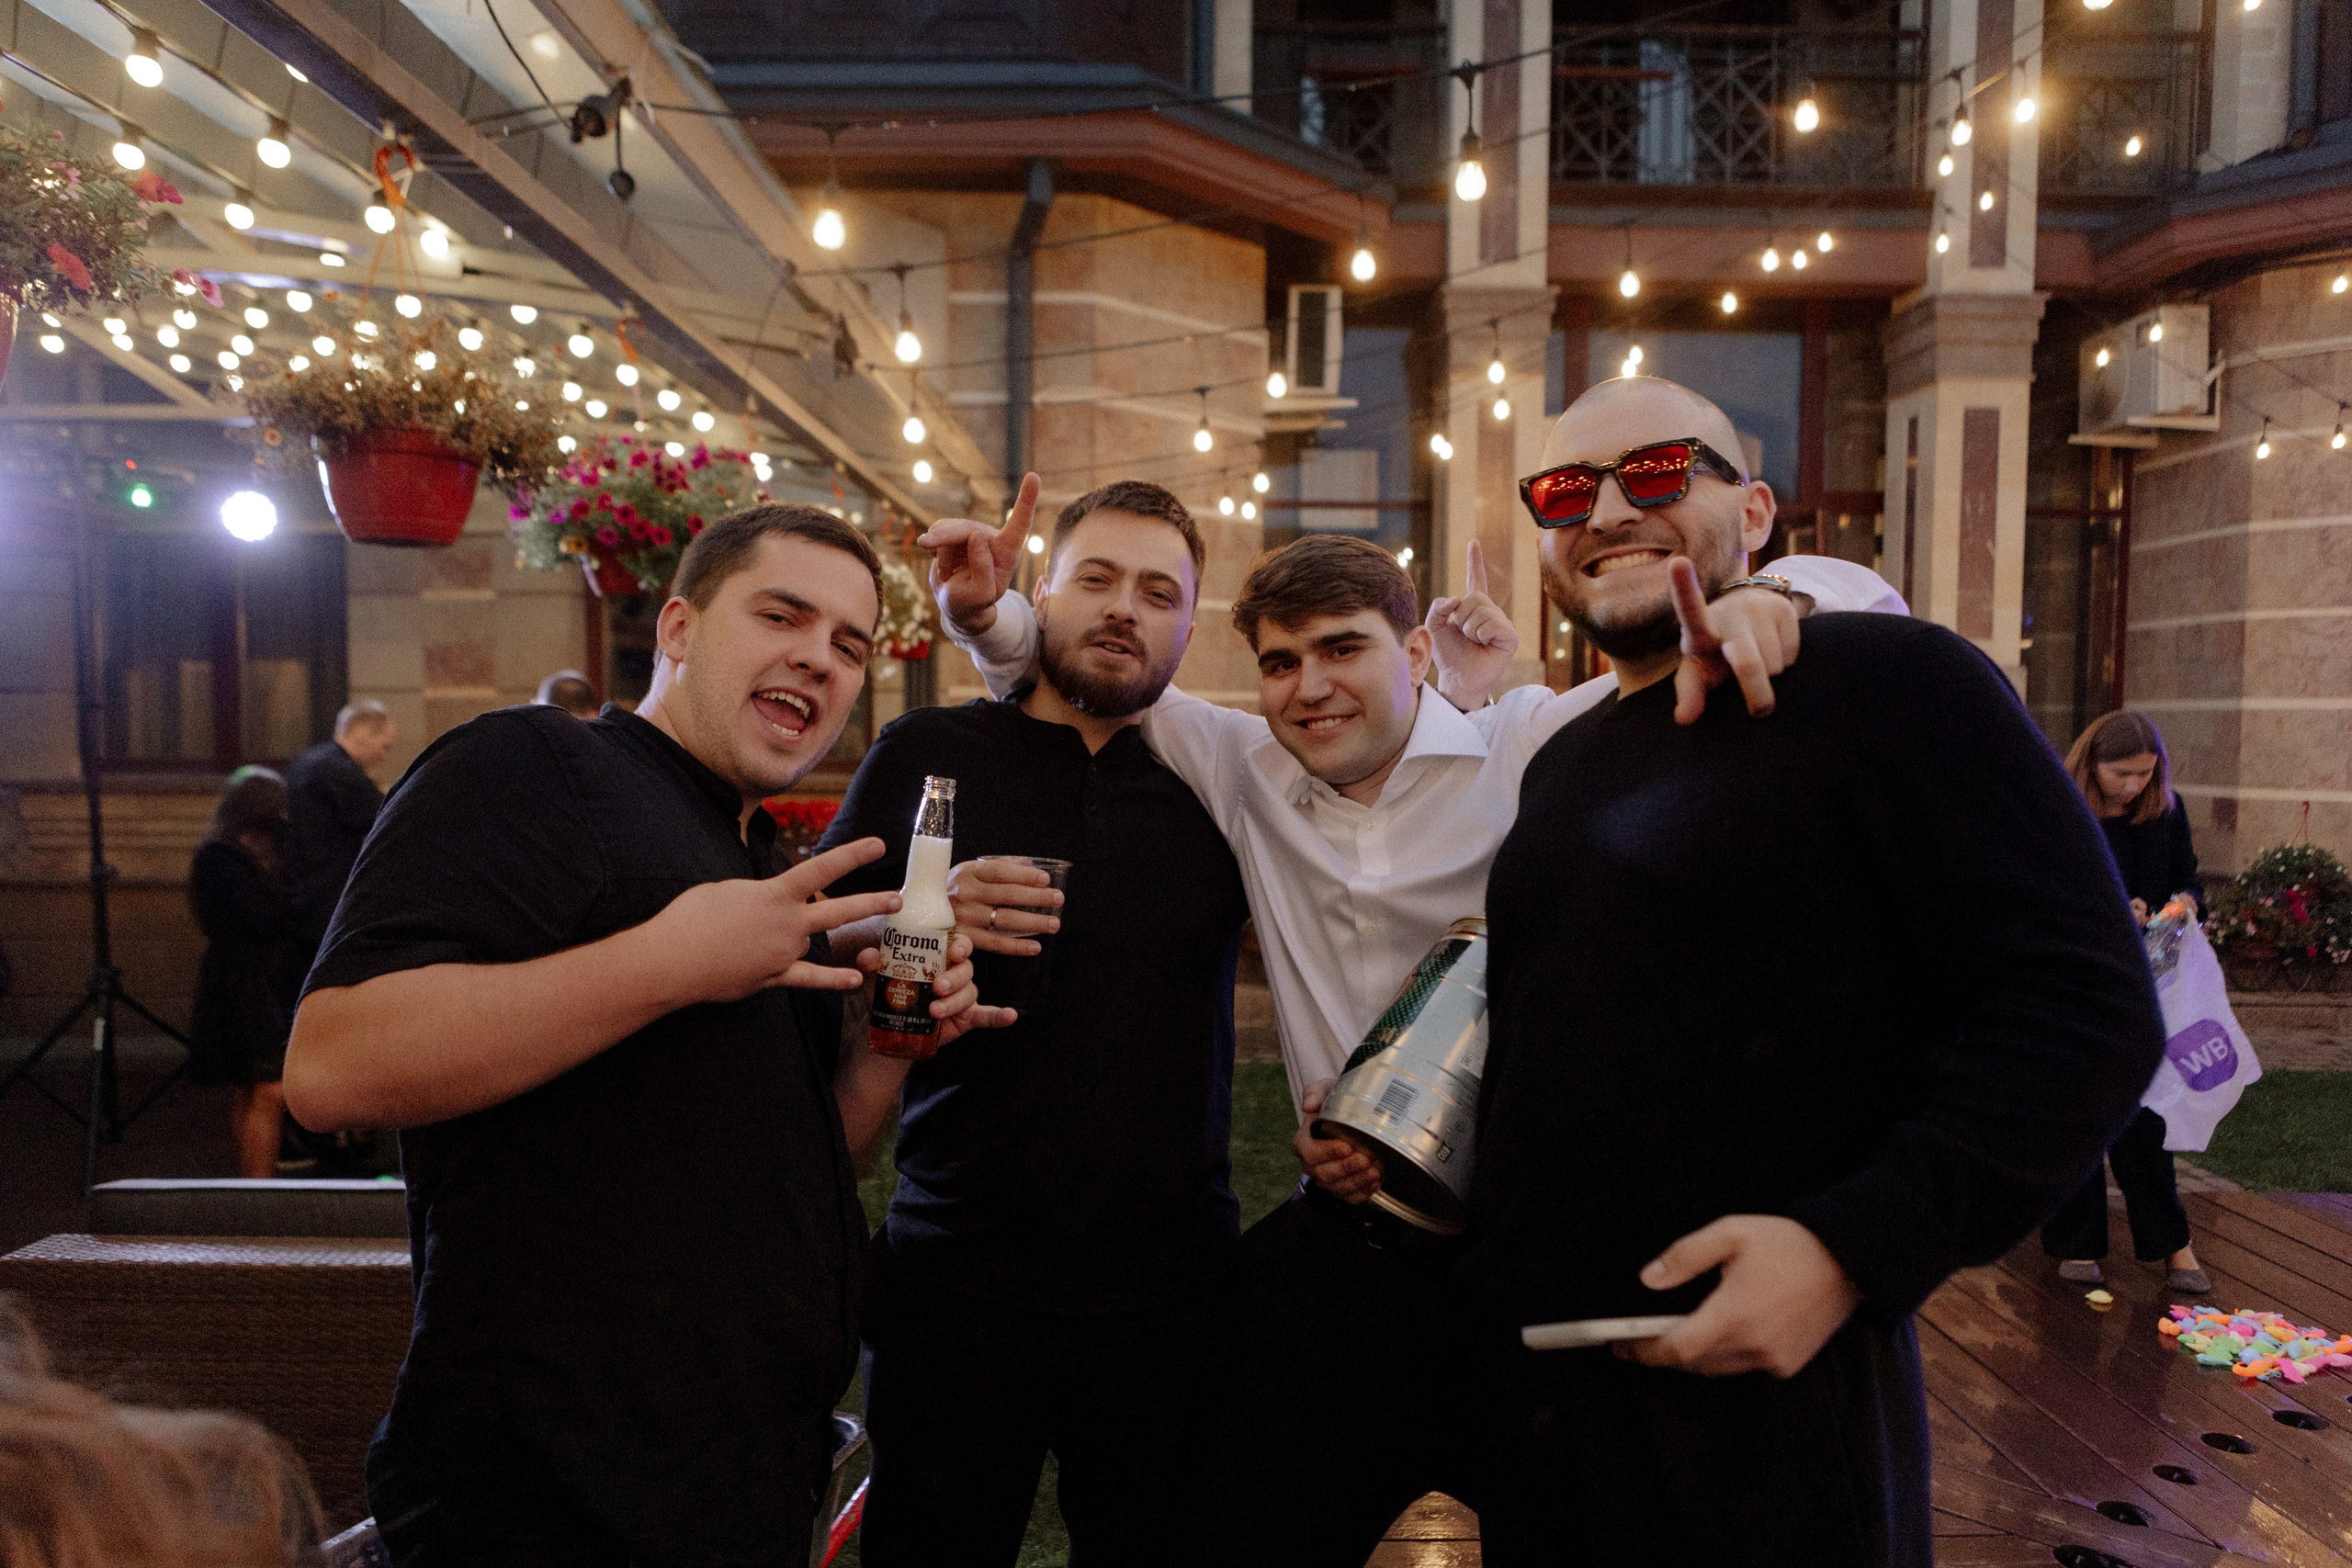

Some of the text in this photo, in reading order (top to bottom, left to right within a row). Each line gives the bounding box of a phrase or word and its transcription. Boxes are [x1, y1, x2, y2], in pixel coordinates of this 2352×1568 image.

[884, 927, 939, 951] Corona
[892, 946, 926, 964] Extra
[888, 987, 915, 996] CERVEZA
[892, 998, 907, 1006] FINA
[2179, 1037, 2229, 1075] WB
